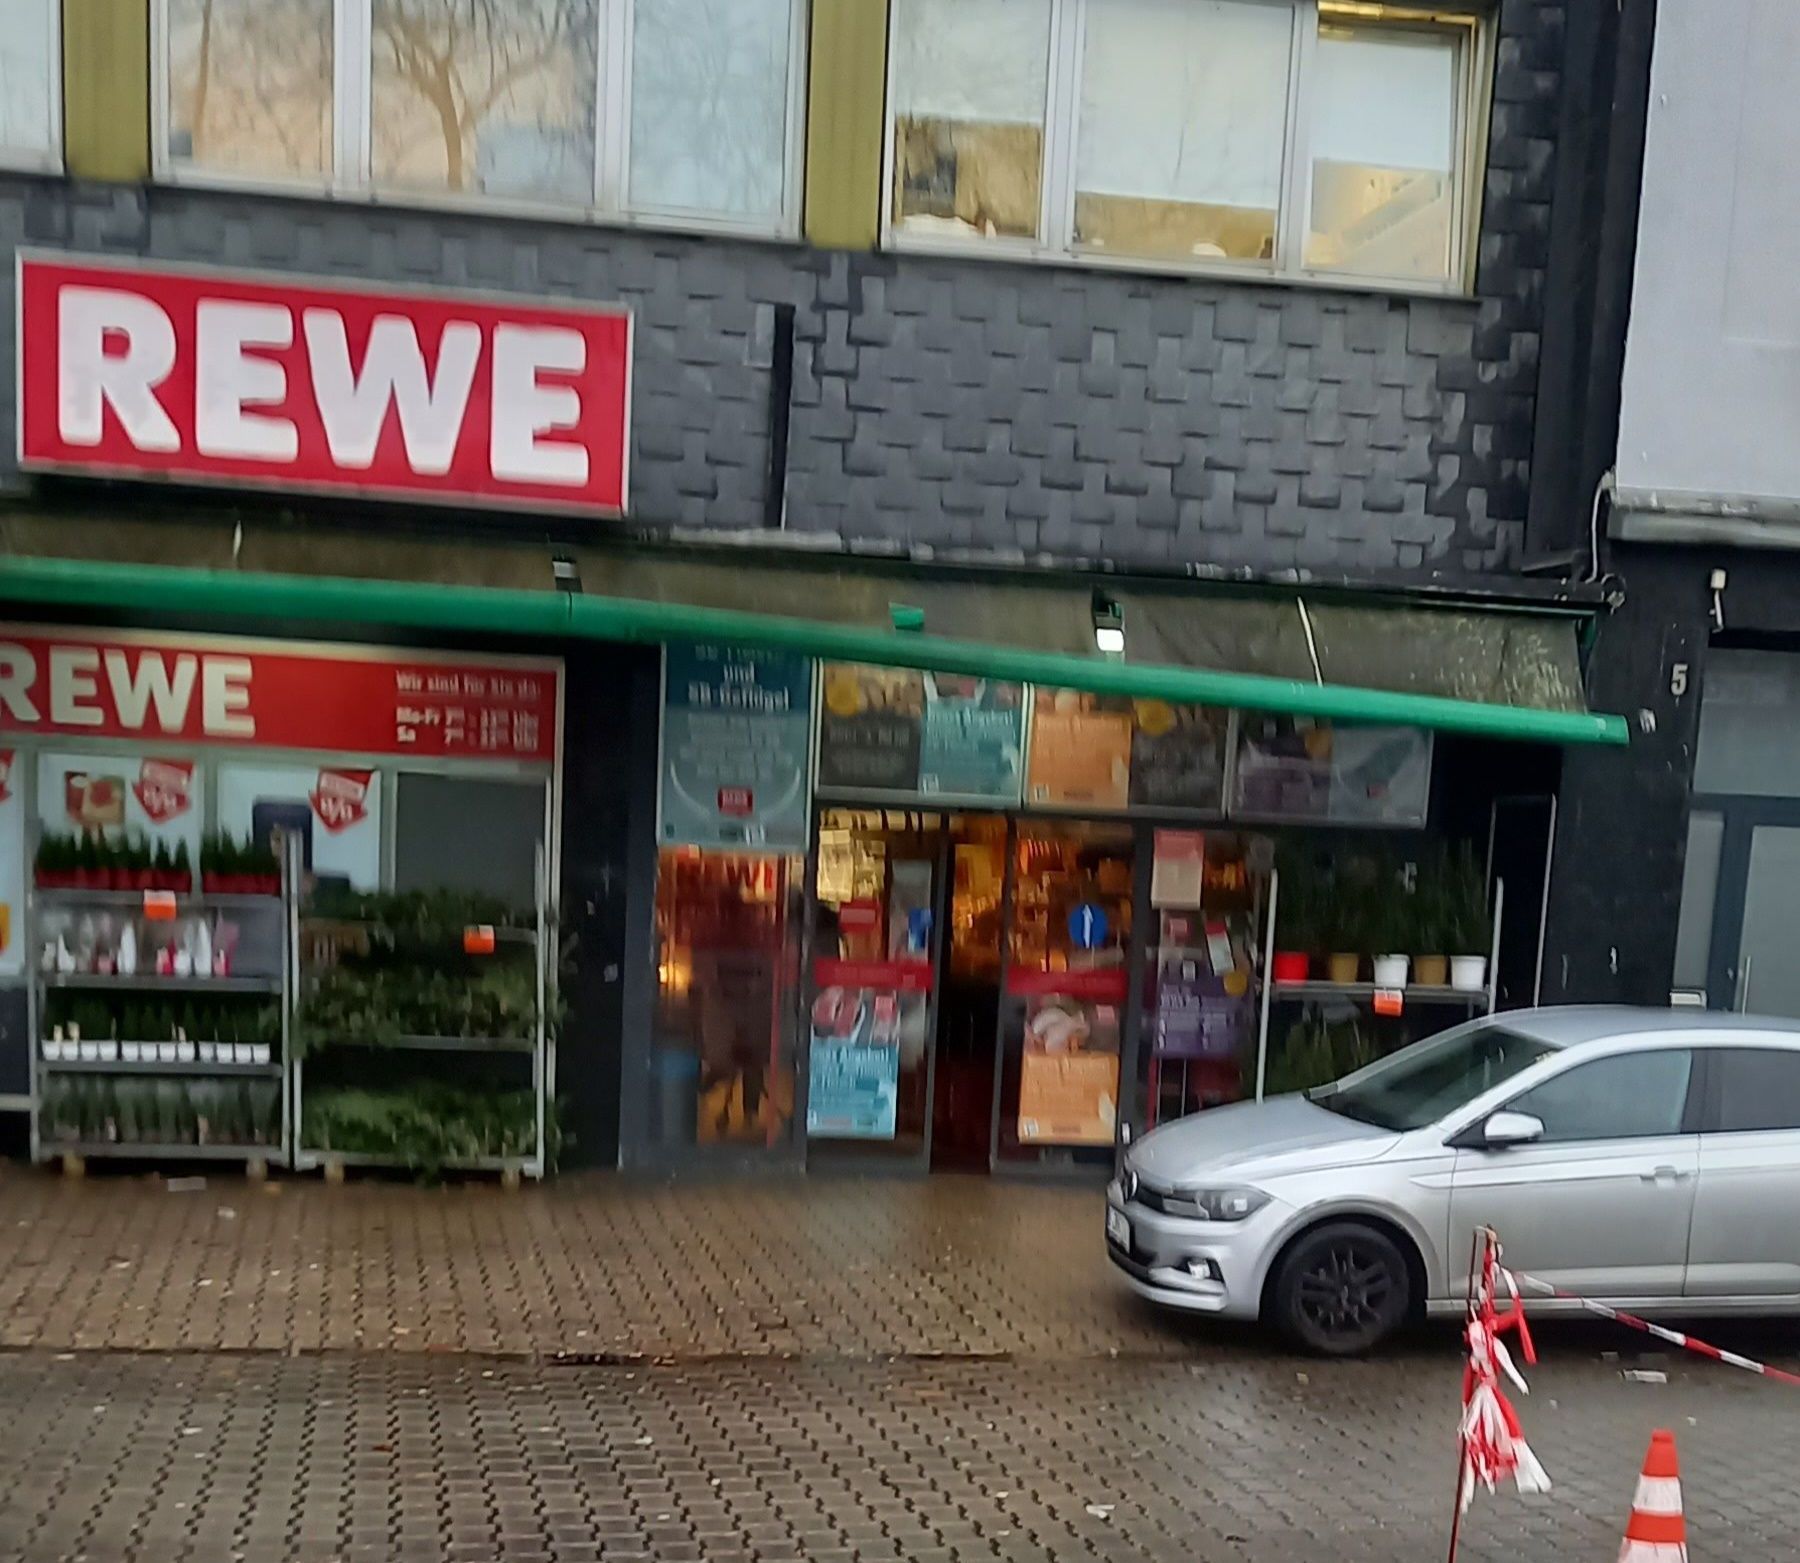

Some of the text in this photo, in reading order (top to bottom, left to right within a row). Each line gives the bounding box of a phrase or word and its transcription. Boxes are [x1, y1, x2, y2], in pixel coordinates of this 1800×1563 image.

[58, 285, 590, 487] REWE
[0, 641, 256, 739] REWE
[1670, 663, 1688, 696] 5
